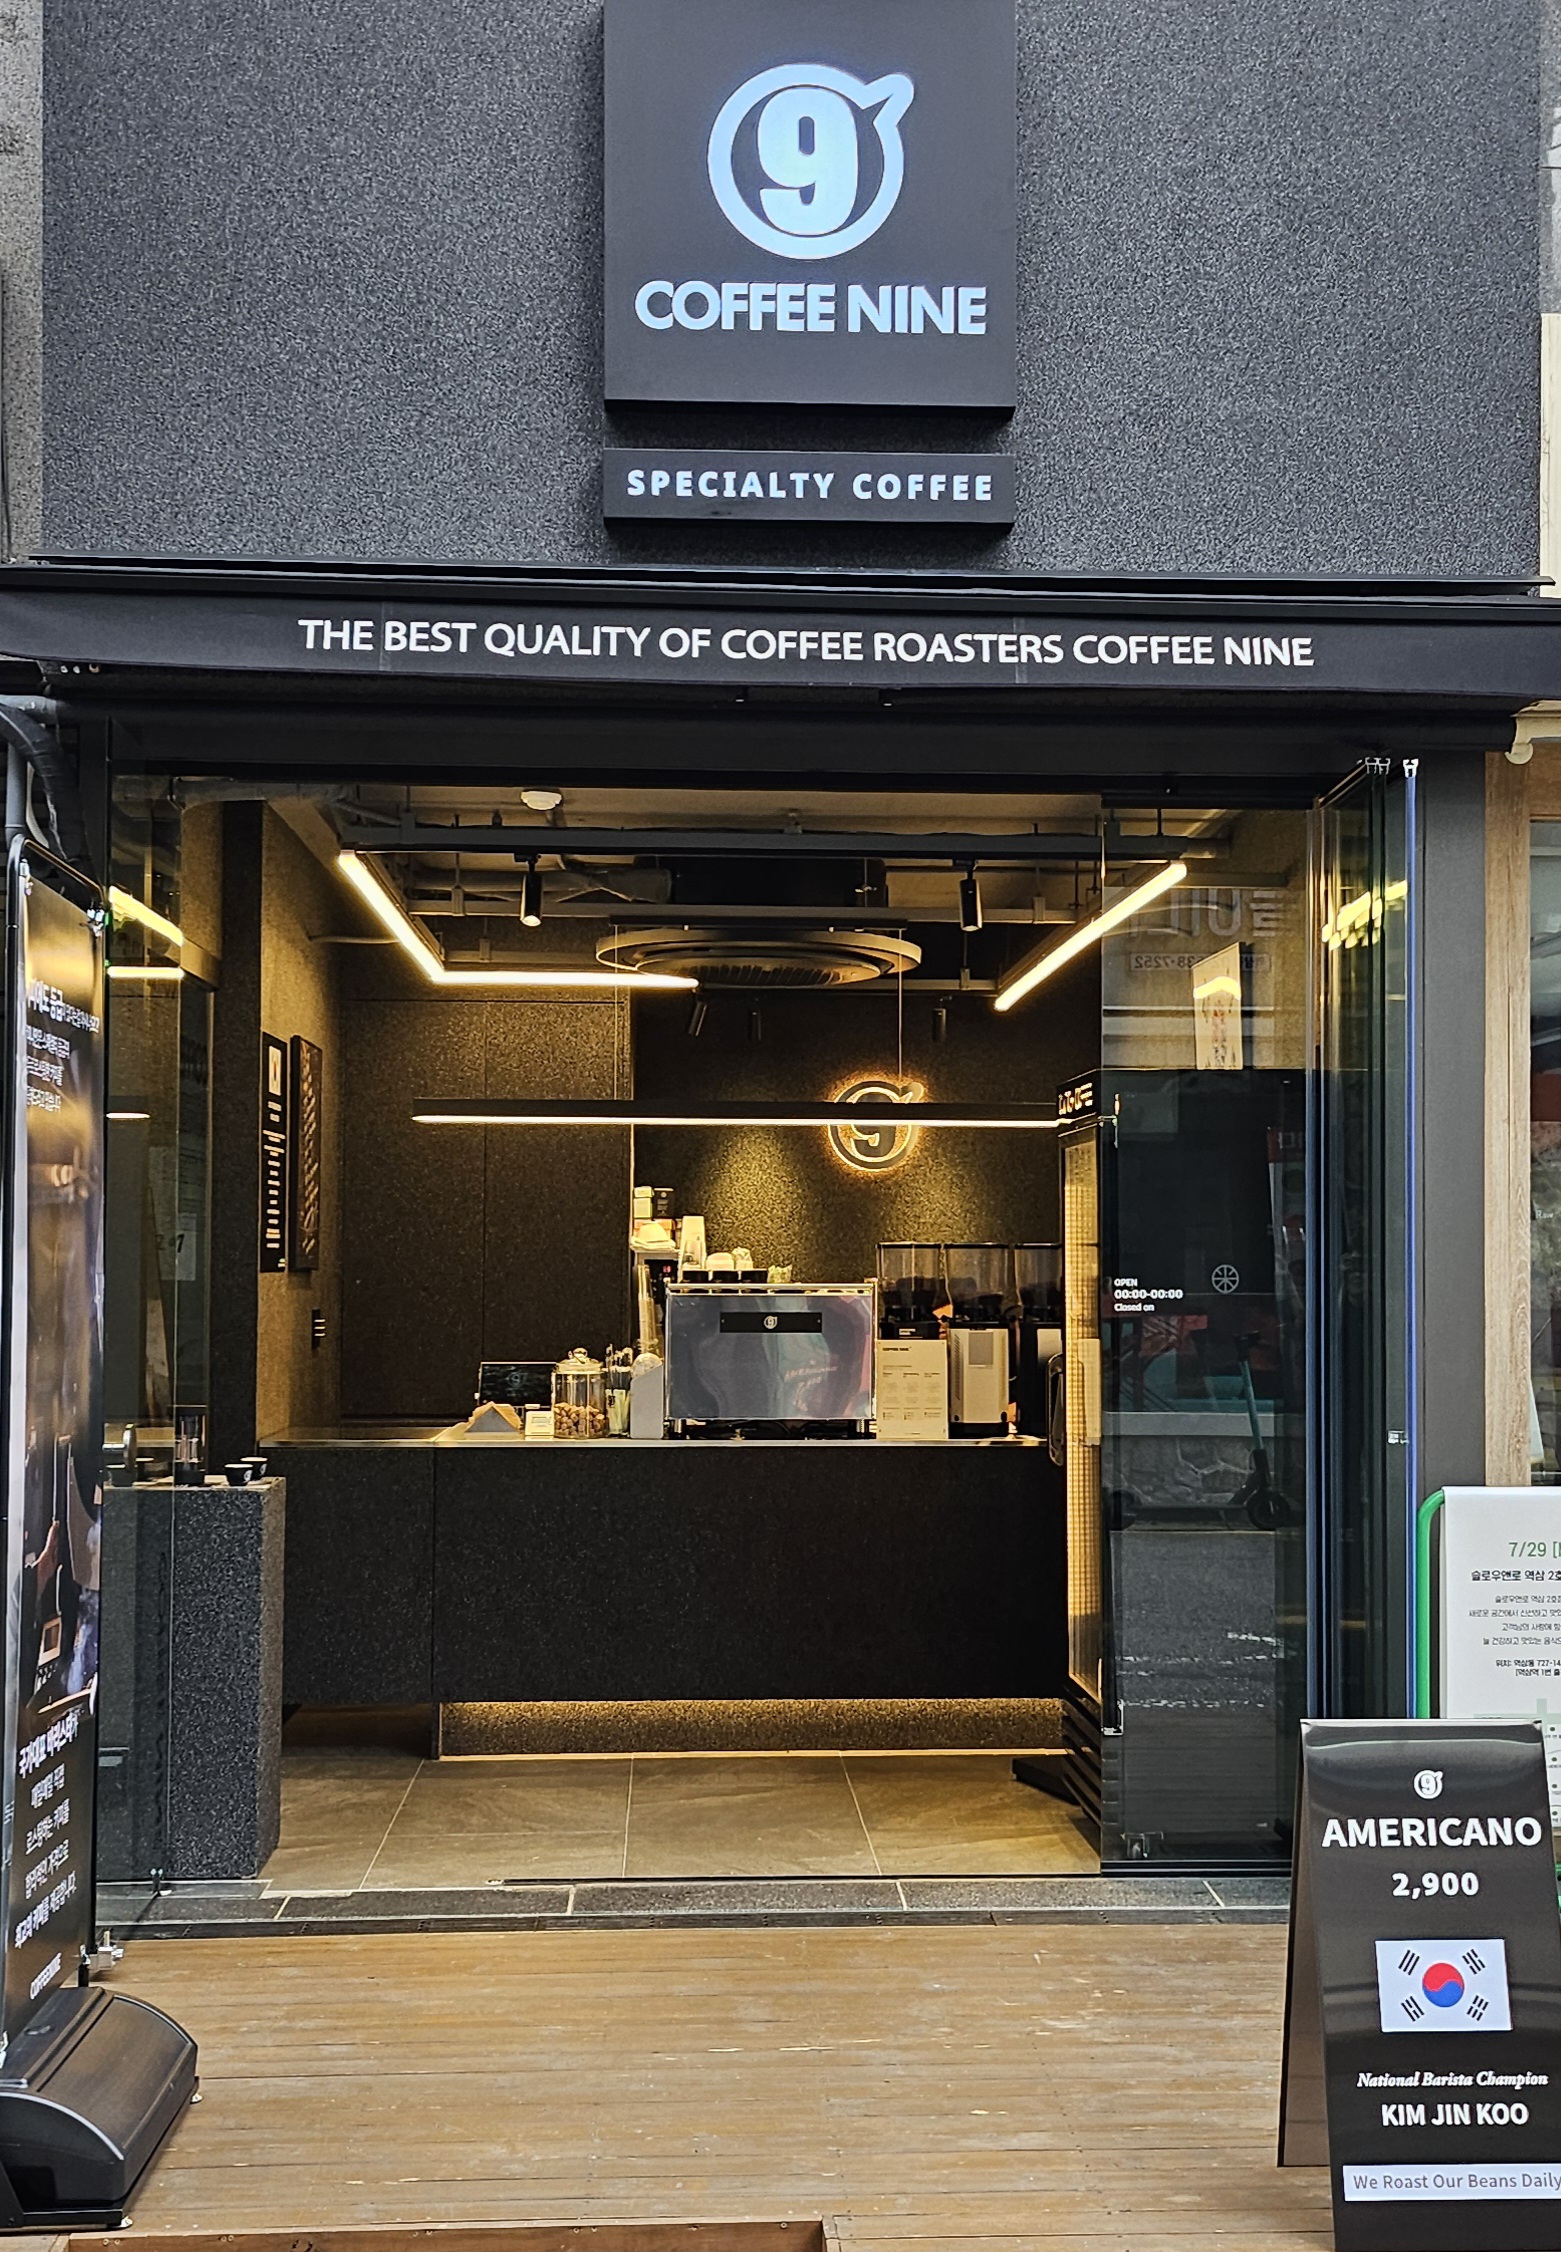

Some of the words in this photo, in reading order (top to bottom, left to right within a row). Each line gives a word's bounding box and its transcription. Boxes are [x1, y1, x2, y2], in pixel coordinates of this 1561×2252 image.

[634, 280, 836, 332] COFFEE
[847, 284, 987, 335] NINE
[627, 469, 835, 499] SPECIALTY
[852, 473, 992, 501] COFFEE
[298, 619, 374, 651] THE
[384, 620, 477, 653] BEST
[484, 622, 651, 657] QUALITY
[658, 627, 712, 658] OF
[721, 628, 864, 661] COFFEE
[873, 632, 1064, 664] ROASTERS
[1072, 634, 1215, 665] COFFEE
[1224, 636, 1315, 667] NINE
[1113, 1278, 1138, 1287] OPEN
[1113, 1289, 1184, 1300] 00:00-00:00
[1113, 1302, 1142, 1312] Closed
[1142, 1304, 1155, 1312] on
[1508, 1541, 1547, 1558] 7/29
[1525, 1570, 1546, 1581] 역삼
[1321, 1817, 1542, 1848] AMERICANO
[1392, 1872, 1479, 1900] 2,900
[1356, 2071, 1421, 2088] National
[1421, 2071, 1474, 2087] Barista
[1476, 2070, 1549, 2090] Champion
[1381, 2103, 1426, 2127] KIM
[1431, 2103, 1471, 2126] JIN
[1476, 2102, 1530, 2126] KOO
[1353, 2175, 1378, 2190] We
[1383, 2175, 1429, 2189] Roast
[1433, 2174, 1464, 2189] Our
[1468, 2174, 1517, 2188] Beans
[1521, 2172, 1561, 2191] Daily
